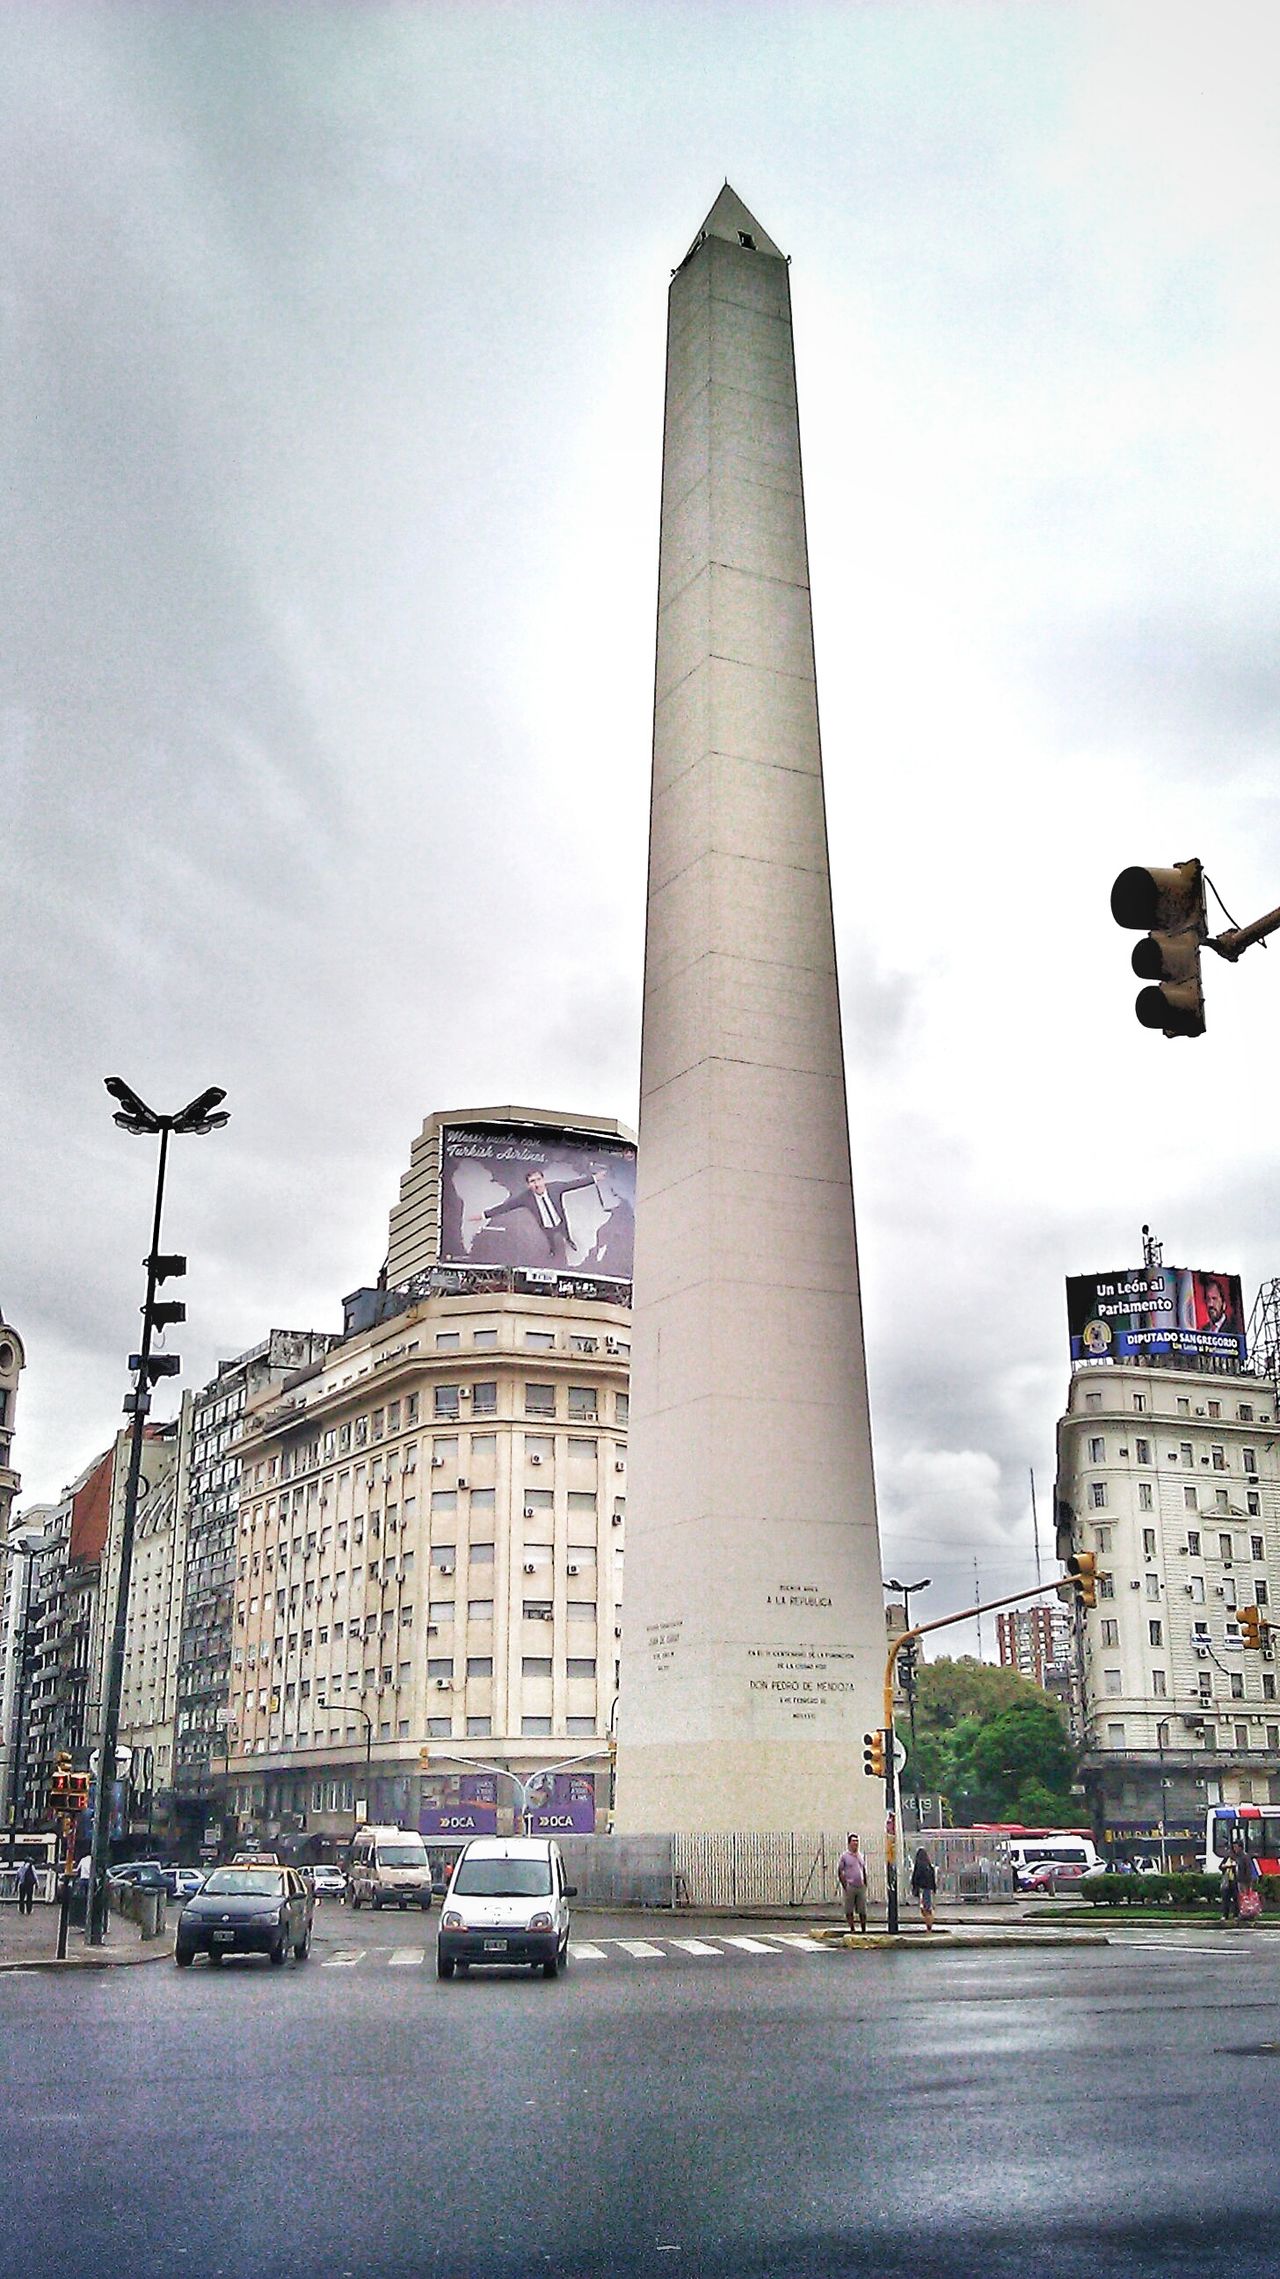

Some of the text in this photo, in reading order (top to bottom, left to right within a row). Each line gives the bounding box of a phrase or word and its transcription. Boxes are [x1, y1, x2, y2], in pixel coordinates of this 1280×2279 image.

[447, 1144, 494, 1158] Turkish
[1097, 1278, 1164, 1297] Un León al
[1098, 1298, 1173, 1317] Parlamento
[1127, 1332, 1178, 1345] DIPUTADO
[772, 1680, 799, 1691] PEDRO
[803, 1681, 813, 1691] DE
[450, 1816, 475, 1828] OCA
[549, 1815, 574, 1827] OCA
